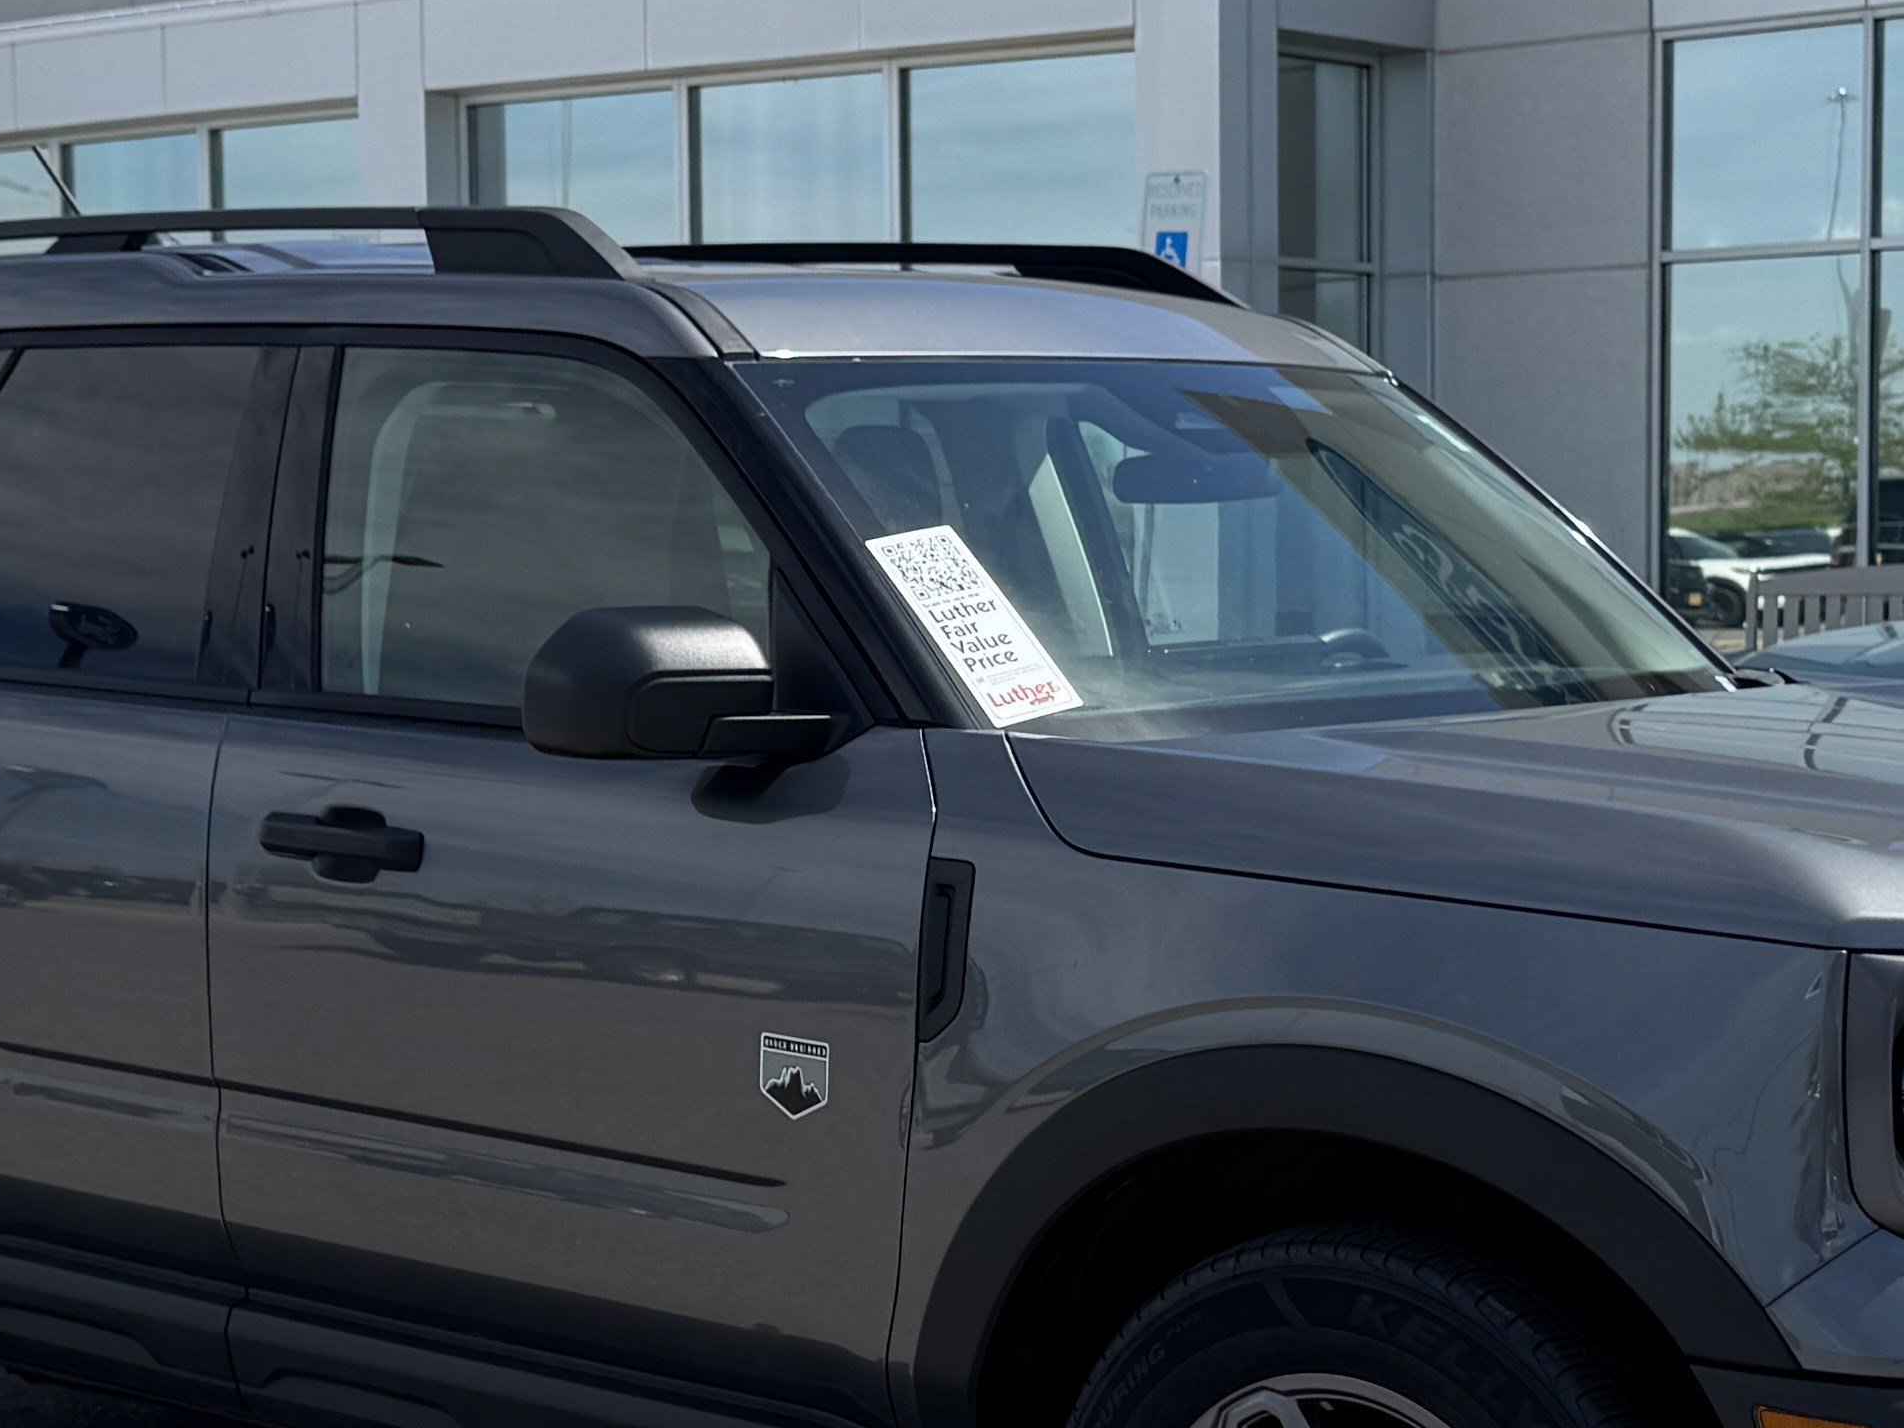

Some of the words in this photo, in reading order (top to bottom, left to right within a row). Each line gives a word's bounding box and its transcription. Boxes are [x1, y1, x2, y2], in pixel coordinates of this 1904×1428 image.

[928, 600, 997, 623] Luther
[940, 620, 979, 640] Fair
[950, 633, 1012, 654] Value
[962, 650, 1018, 673] Price
[986, 681, 1055, 708] Luther
